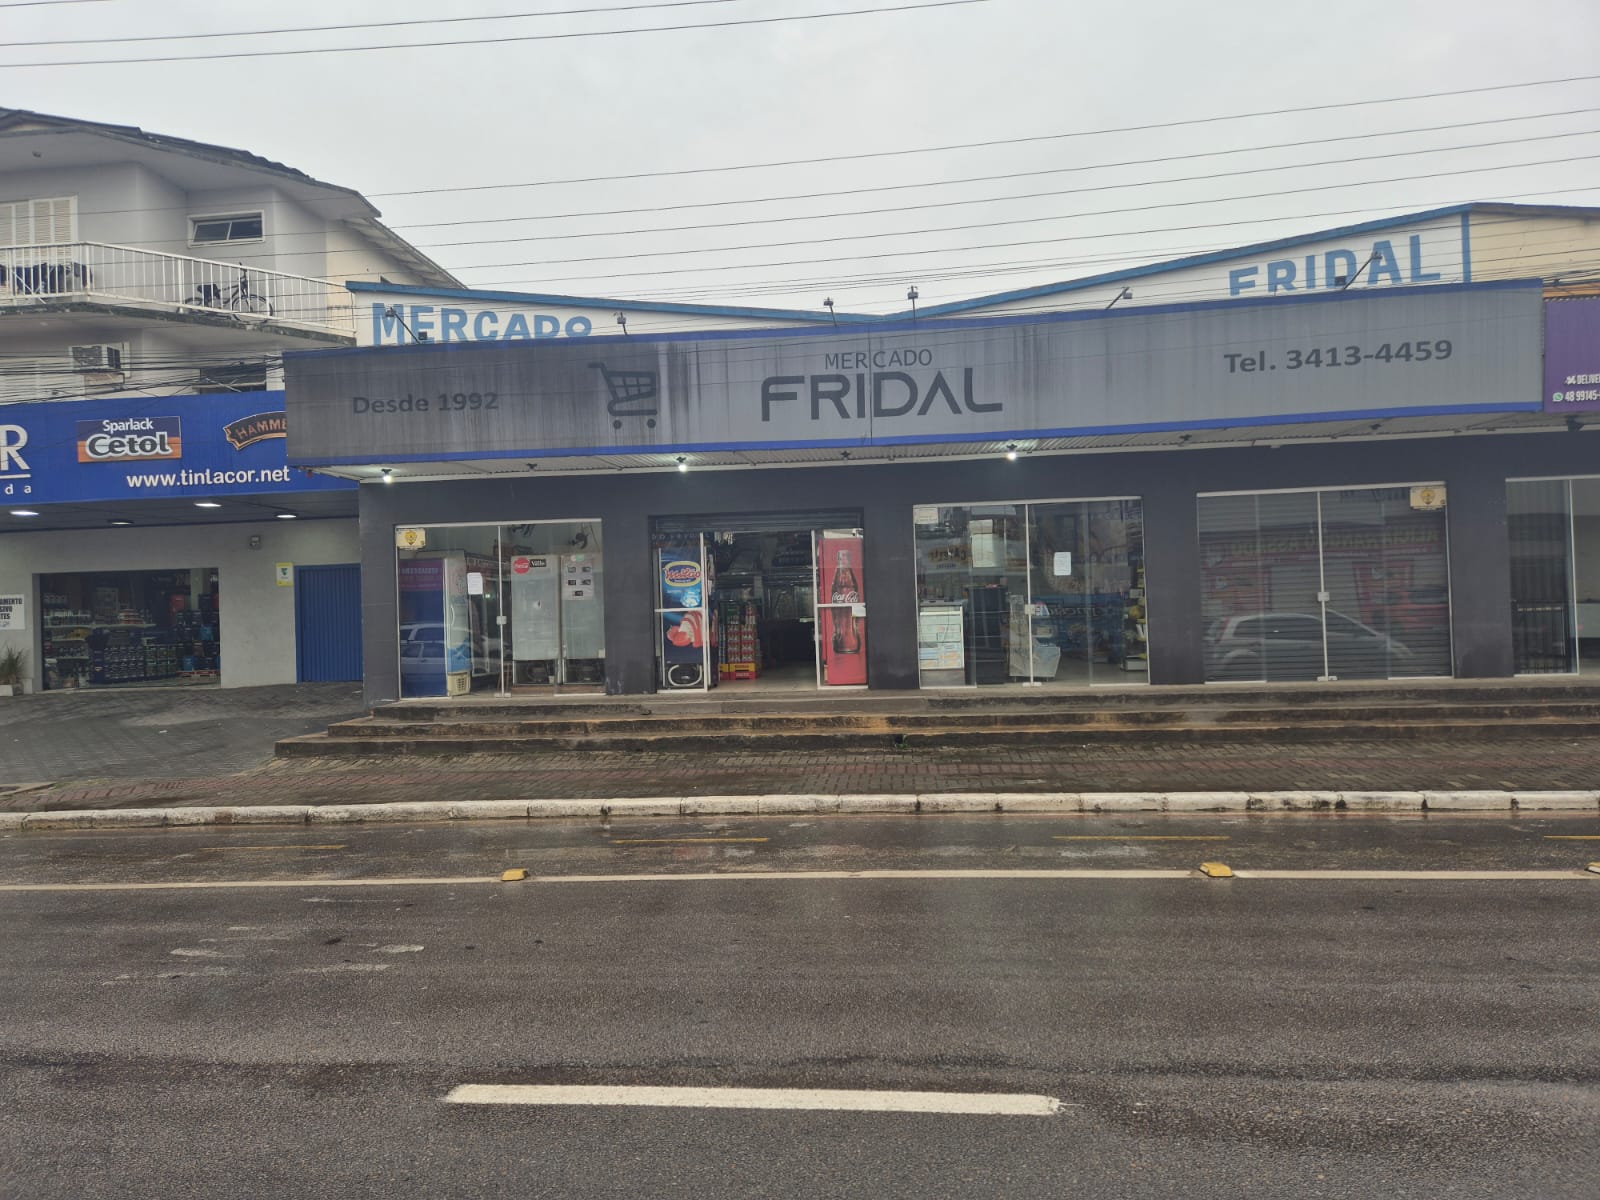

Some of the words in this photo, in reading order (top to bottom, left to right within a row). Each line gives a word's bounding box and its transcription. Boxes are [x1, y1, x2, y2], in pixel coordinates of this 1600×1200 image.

[1229, 234, 1441, 296] FRIDAL
[372, 302, 593, 345] MERCADO
[825, 349, 933, 370] MERCADO
[1224, 350, 1276, 373] Tel.
[1285, 339, 1453, 370] 3413-4459
[1576, 374, 1600, 385] DELIVE
[353, 394, 429, 414] Desde
[438, 391, 499, 412] 1992
[761, 367, 1003, 422] FRIDAL
[1565, 390, 1575, 402] 48
[1576, 390, 1600, 401] 99145-
[102, 417, 154, 434] Sparlack
[86, 431, 173, 459] Cetol
